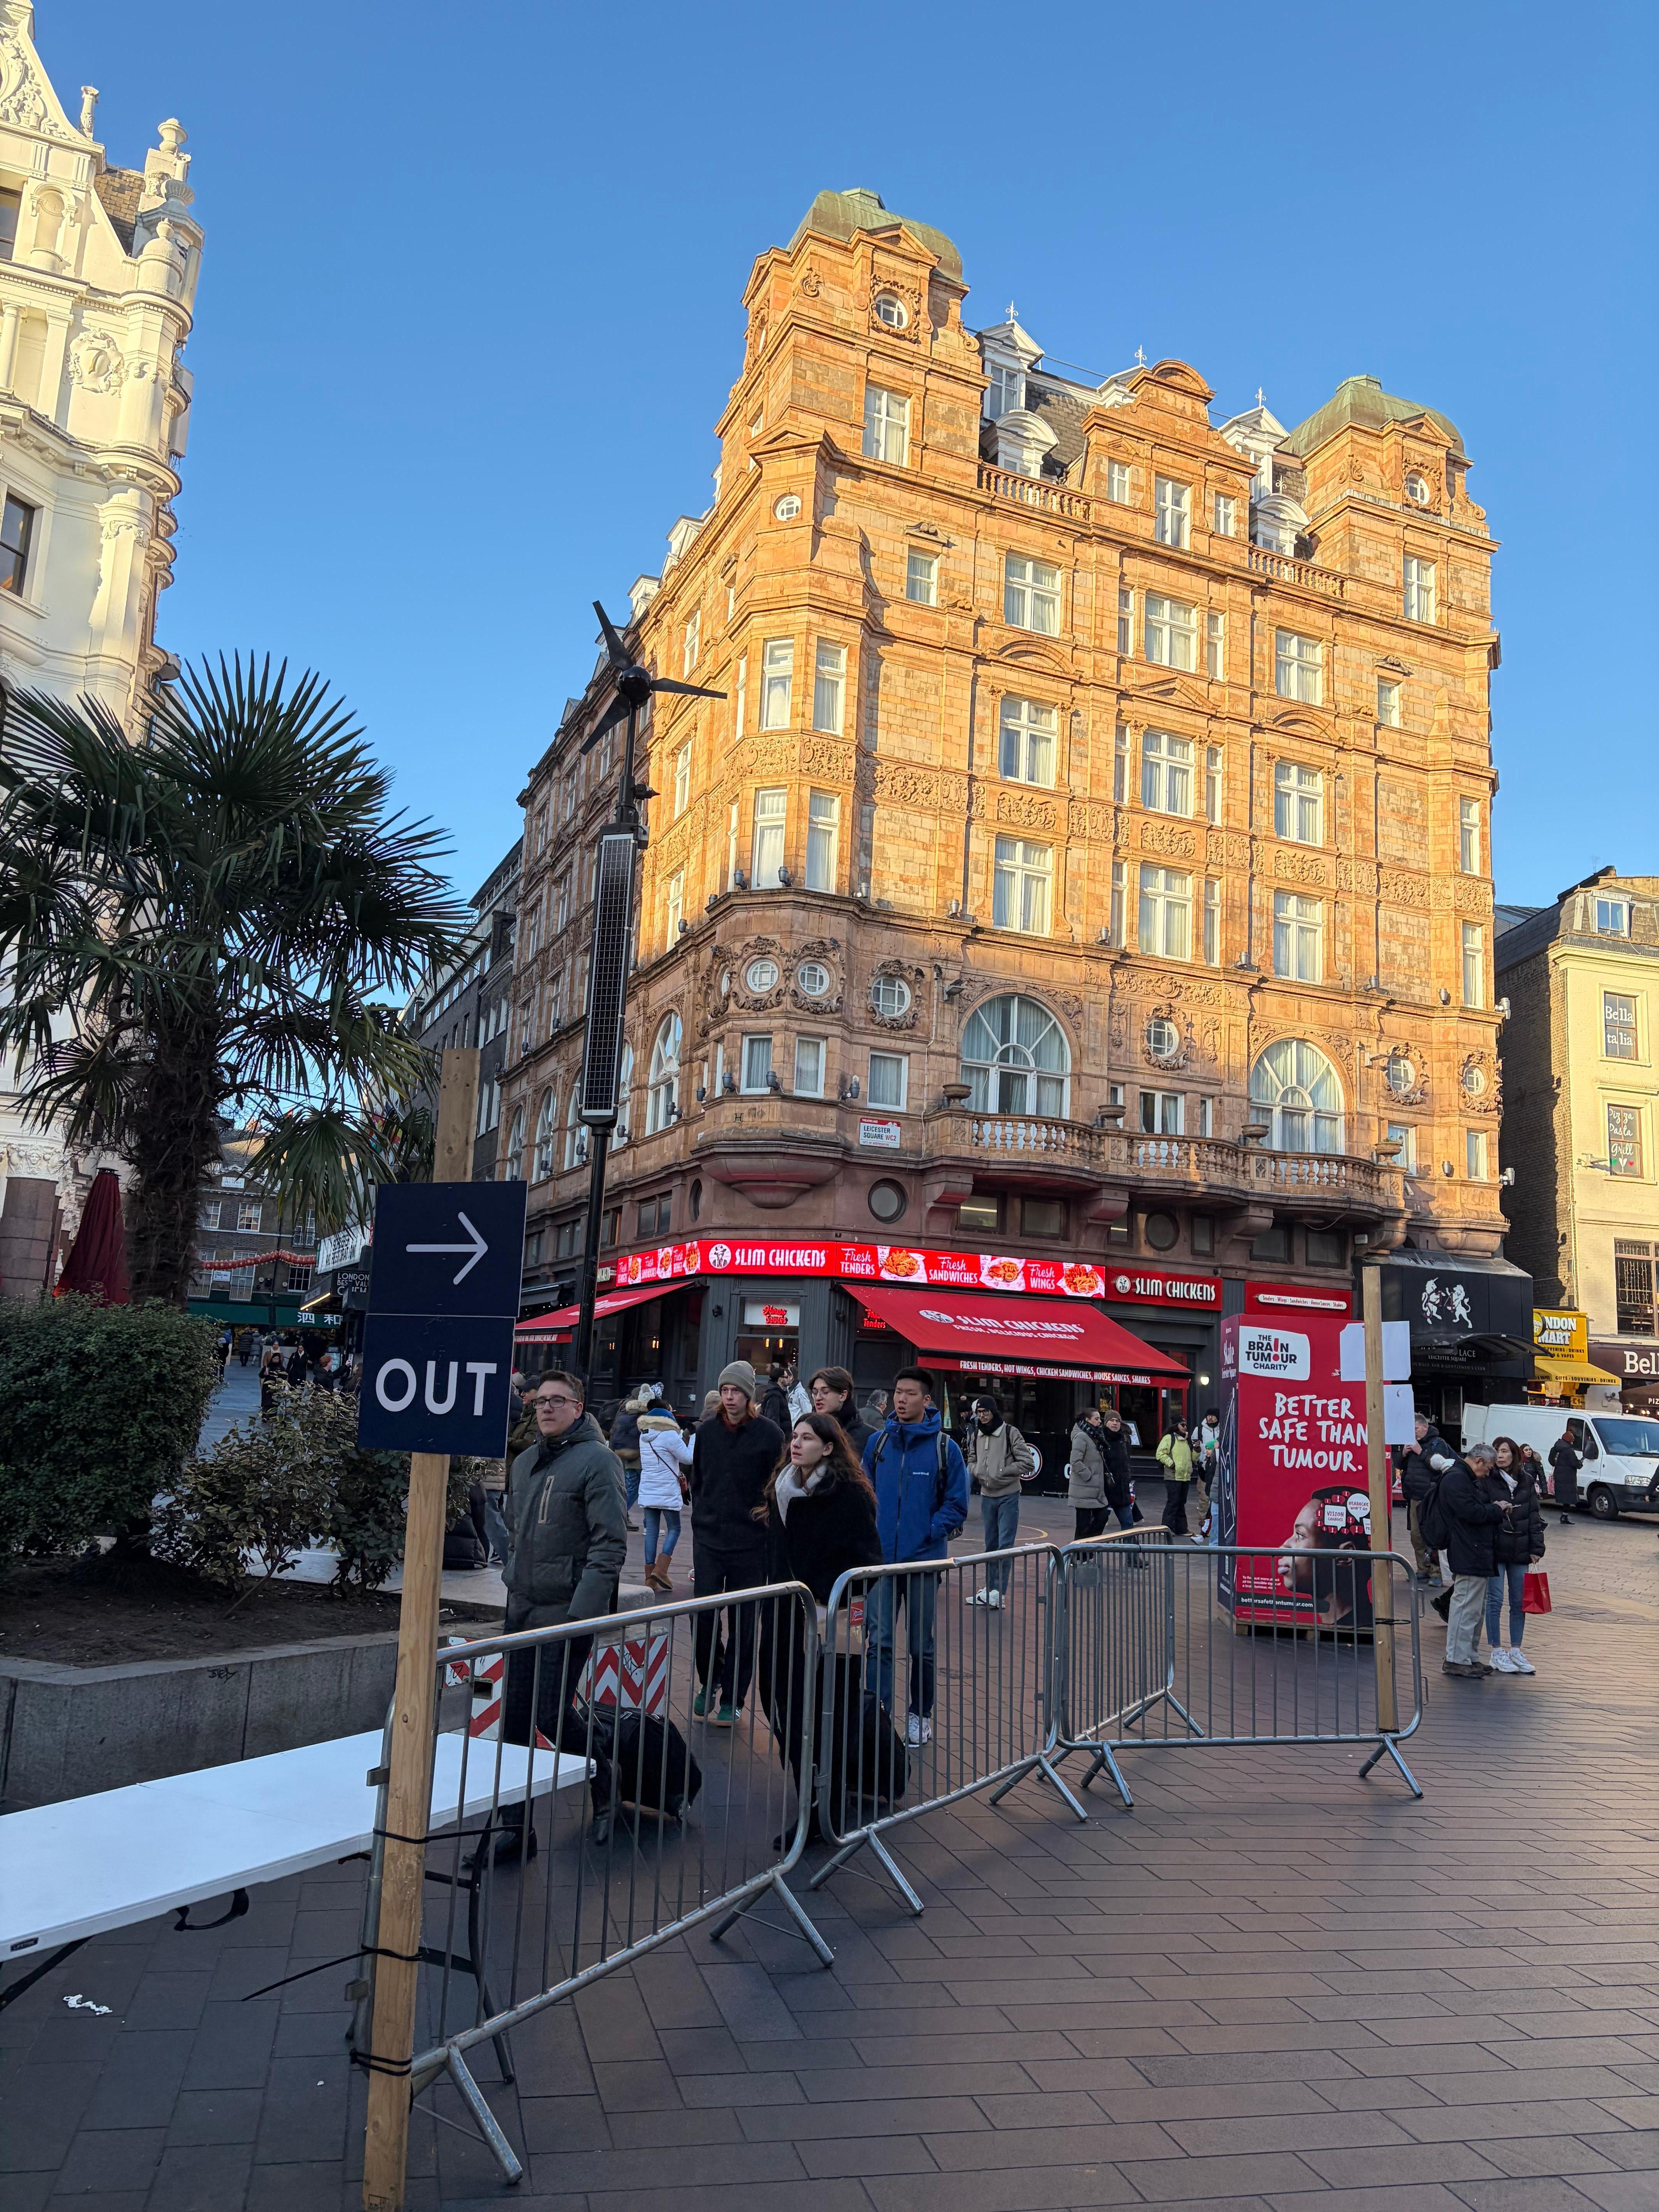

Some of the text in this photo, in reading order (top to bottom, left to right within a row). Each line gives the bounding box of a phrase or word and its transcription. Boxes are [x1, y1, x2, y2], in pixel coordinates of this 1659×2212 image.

[1605, 1005, 1634, 1022] Bella
[1607, 1032, 1633, 1046] talia
[864, 1125, 890, 1133] LEICESTER
[1611, 1143, 1633, 1156] Grill
[735, 1248, 826, 1267] SLIM CHICKENS
[841, 1248, 872, 1262] Fresh
[840, 1262, 875, 1275] TENDERS
[937, 1256, 967, 1271] Fresh
[1027, 1264, 1055, 1278] Fresh
[929, 1269, 978, 1284] SANDWICHES
[1030, 1277, 1055, 1290] WINGS
[1135, 1277, 1216, 1301] SLIM CHICKENS
[864, 1318, 886, 1328] Tenders
[956, 1316, 1085, 1333] SLIM CHICKENS
[1543, 1316, 1577, 1331] NDON
[988, 1329, 1038, 1338] DELICIOUS
[1538, 1331, 1571, 1345] MART
[960, 1361, 1151, 1384] FRESH TENDERS, HOT WINGS, CHICKEN SANDWICHES, HOUSE SAUCES, SHAKES
[1253, 1363, 1288, 1371] CHARITY
[376, 1358, 497, 1415] OUT
[1275, 1393, 1355, 1419] BETTER
[1259, 1417, 1368, 1446] SAFE THAN
[1269, 1445, 1362, 1472] TUMOUR.
